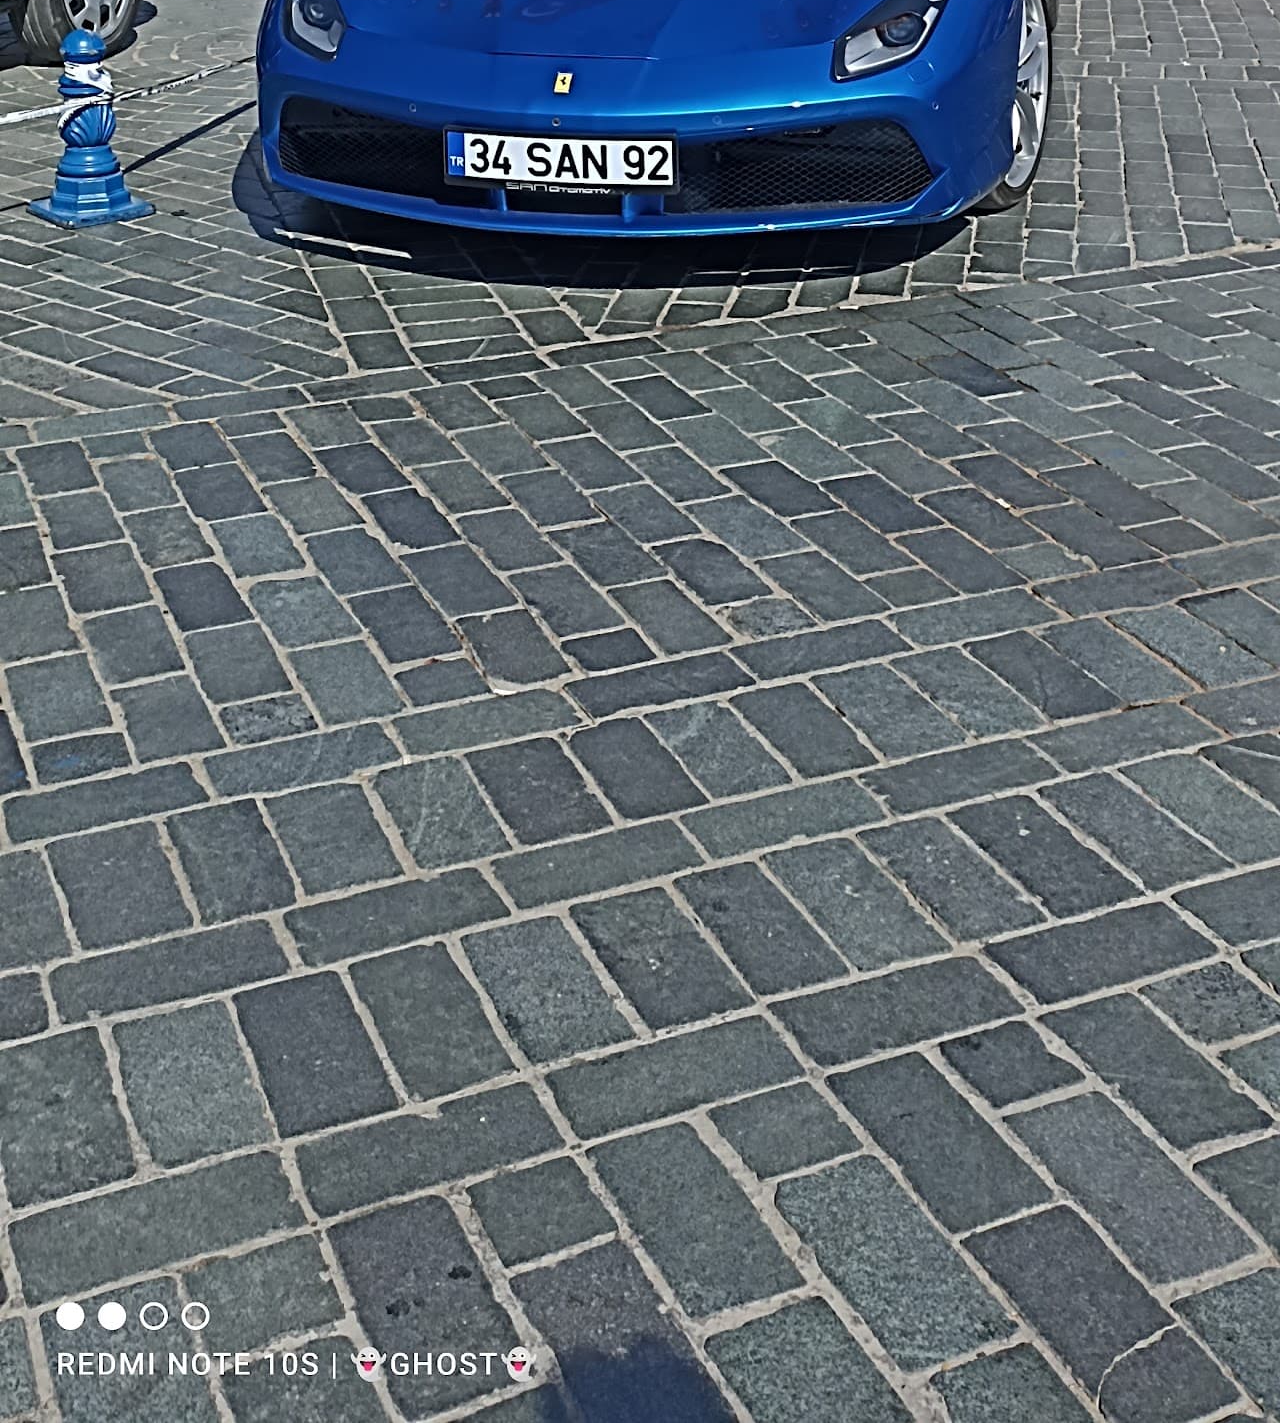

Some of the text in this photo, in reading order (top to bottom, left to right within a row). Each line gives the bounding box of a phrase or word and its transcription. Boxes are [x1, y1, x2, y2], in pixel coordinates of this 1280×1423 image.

[450, 138, 670, 181] TR 34 SAN 92
